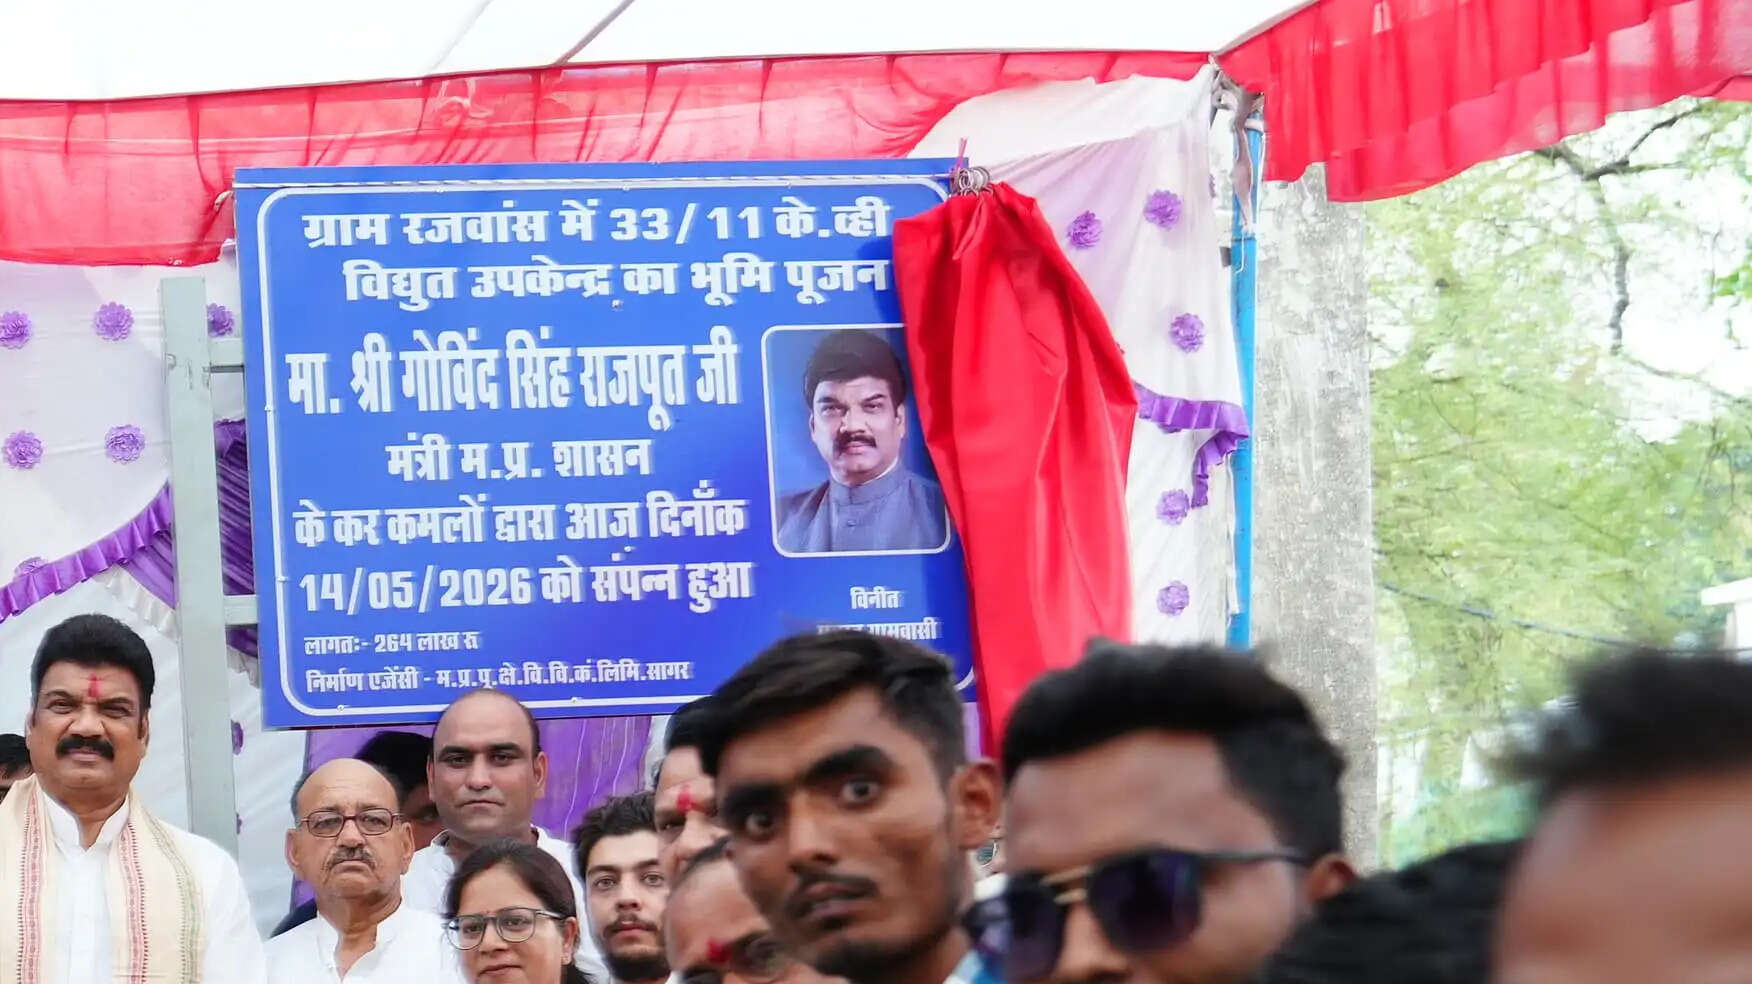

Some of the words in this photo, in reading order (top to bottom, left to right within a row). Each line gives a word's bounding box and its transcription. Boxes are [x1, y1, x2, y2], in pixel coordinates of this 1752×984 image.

[301, 213, 391, 249] ग्राम
[399, 199, 549, 245] रजवांस
[558, 198, 599, 241] में
[609, 203, 760, 245] 33/11
[342, 259, 458, 312] विद्युत
[467, 254, 614, 298] उपकेन्द्र
[620, 263, 679, 295] का
[690, 252, 775, 306] भूमि
[783, 260, 889, 305] पूजन
[285, 353, 340, 414] मा.
[350, 332, 392, 413] श्री
[399, 327, 500, 412] गोविंद
[505, 325, 572, 409] सिंह
[576, 345, 687, 431] राजपूत
[692, 325, 739, 405] जी
[385, 432, 452, 482] मंत्री
[458, 442, 542, 481] म.प्र.
[551, 439, 652, 477] शासन
[292, 499, 326, 548] के
[330, 509, 381, 546] कर
[384, 493, 487, 545] कमलों
[492, 504, 556, 542] द्वारा
[565, 501, 640, 540] आज
[299, 565, 532, 615] 14/05/2026
[538, 555, 583, 604] को
[589, 551, 680, 602] संपन्न
[685, 562, 752, 613] हुआ
[850, 586, 900, 610] विनीत
[374, 633, 412, 653] 264
[416, 631, 460, 651] लाख
[305, 667, 364, 693] निर्माण
[367, 665, 419, 690] एजेंसी
